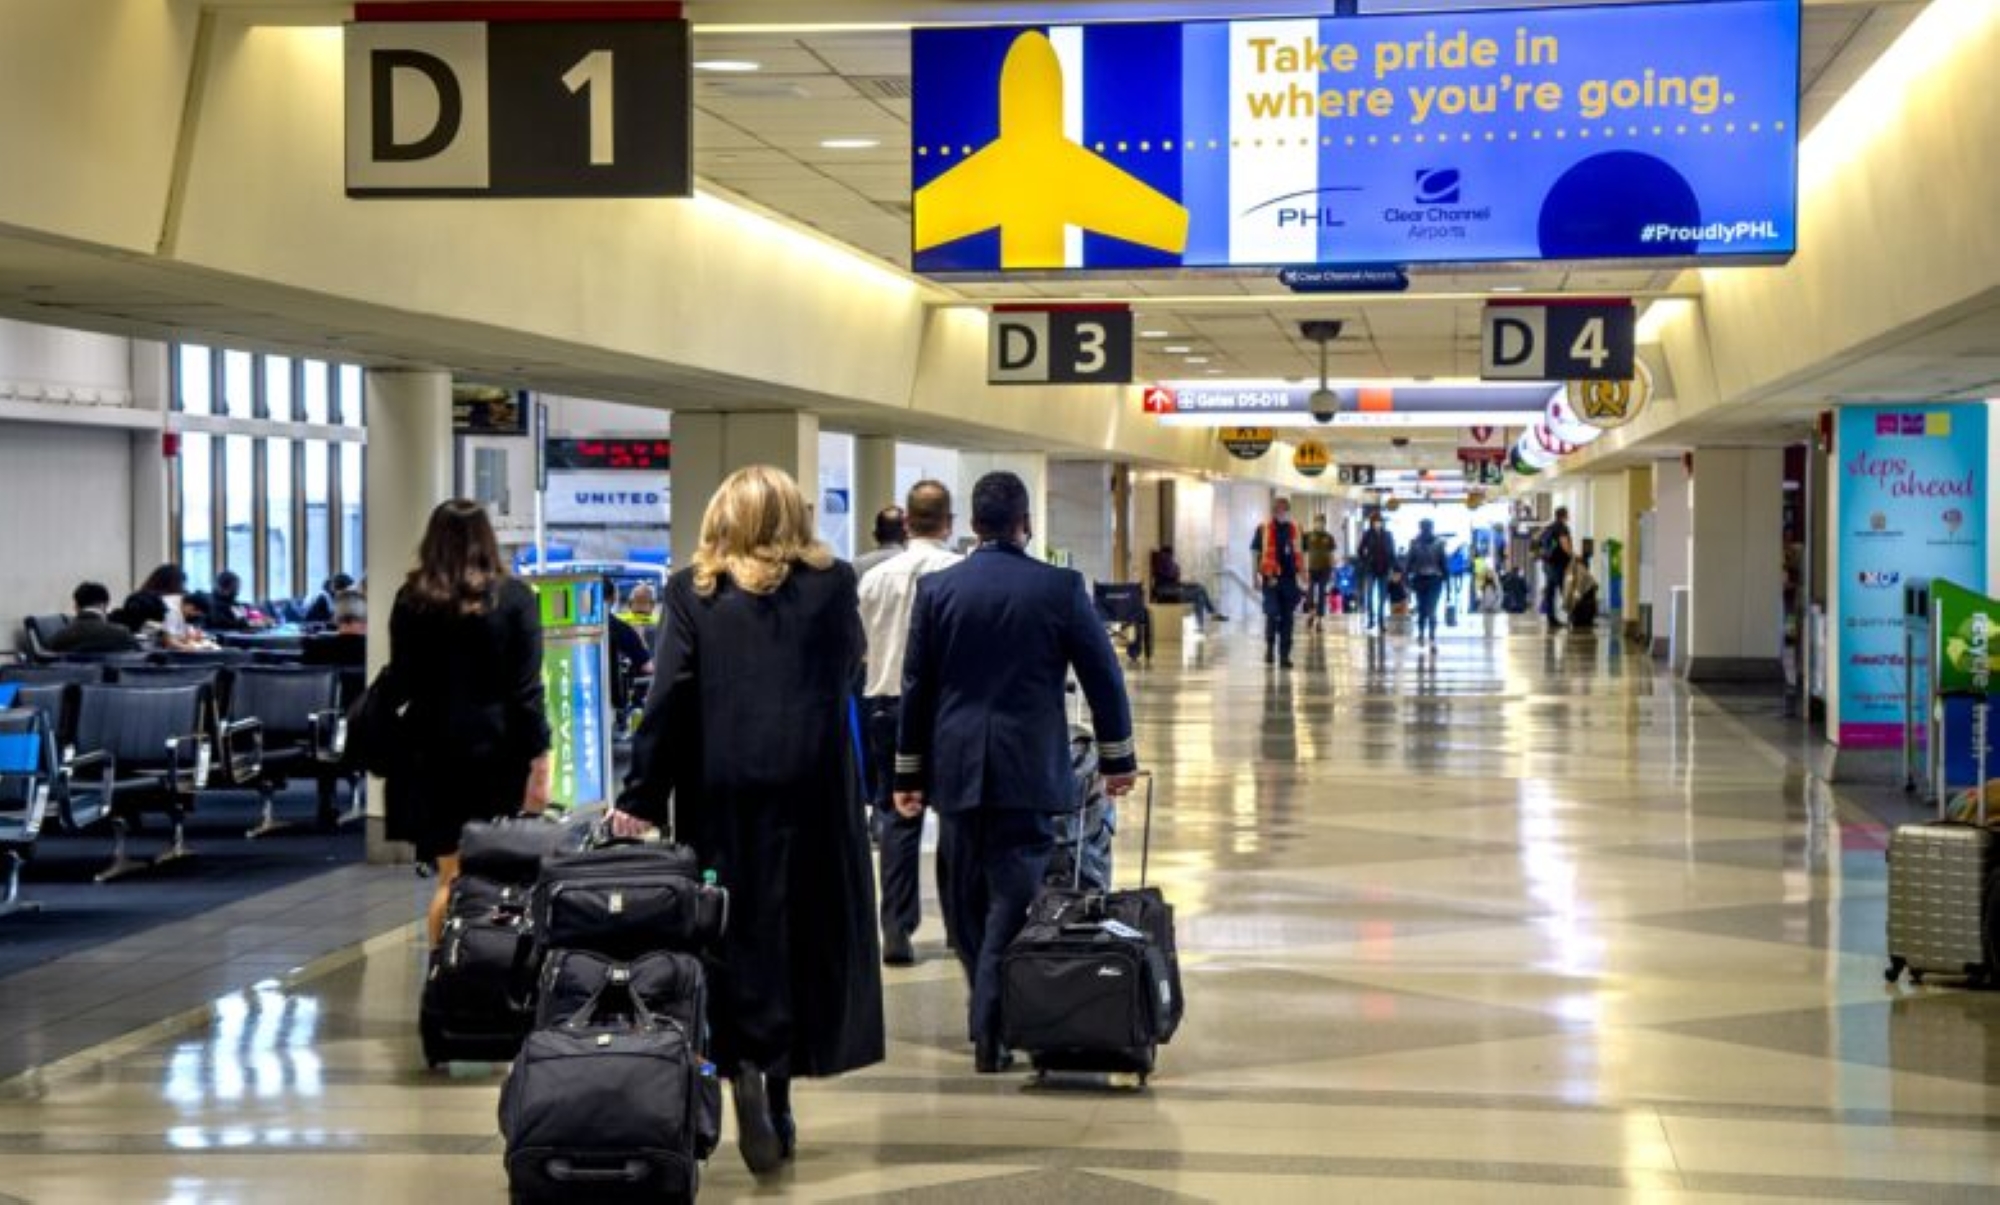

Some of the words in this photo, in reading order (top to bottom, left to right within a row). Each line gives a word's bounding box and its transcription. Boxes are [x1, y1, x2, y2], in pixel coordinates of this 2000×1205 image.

[1247, 37, 1358, 73] Take
[1374, 30, 1499, 79] pride
[1515, 27, 1559, 66] in
[371, 49, 463, 163] D
[561, 50, 614, 166] 1
[1247, 83, 1394, 118] where
[1578, 67, 1736, 118] going.
[1277, 208, 1346, 227] PHL
[1385, 207, 1423, 223] Clear
[1428, 205, 1491, 222] Channel
[1408, 225, 1465, 239] Airports
[1640, 220, 1779, 243] #ProudlyPHL
[998, 322, 1038, 371] D
[1074, 321, 1108, 374] 3
[1493, 317, 1534, 368] D
[1569, 317, 1610, 369] 4
[1197, 394, 1236, 409] Gates
[1846, 449, 1907, 489] steps
[1893, 469, 1974, 498] ahead
[575, 492, 659, 504] UNITED
[559, 658, 574, 797] recycle
